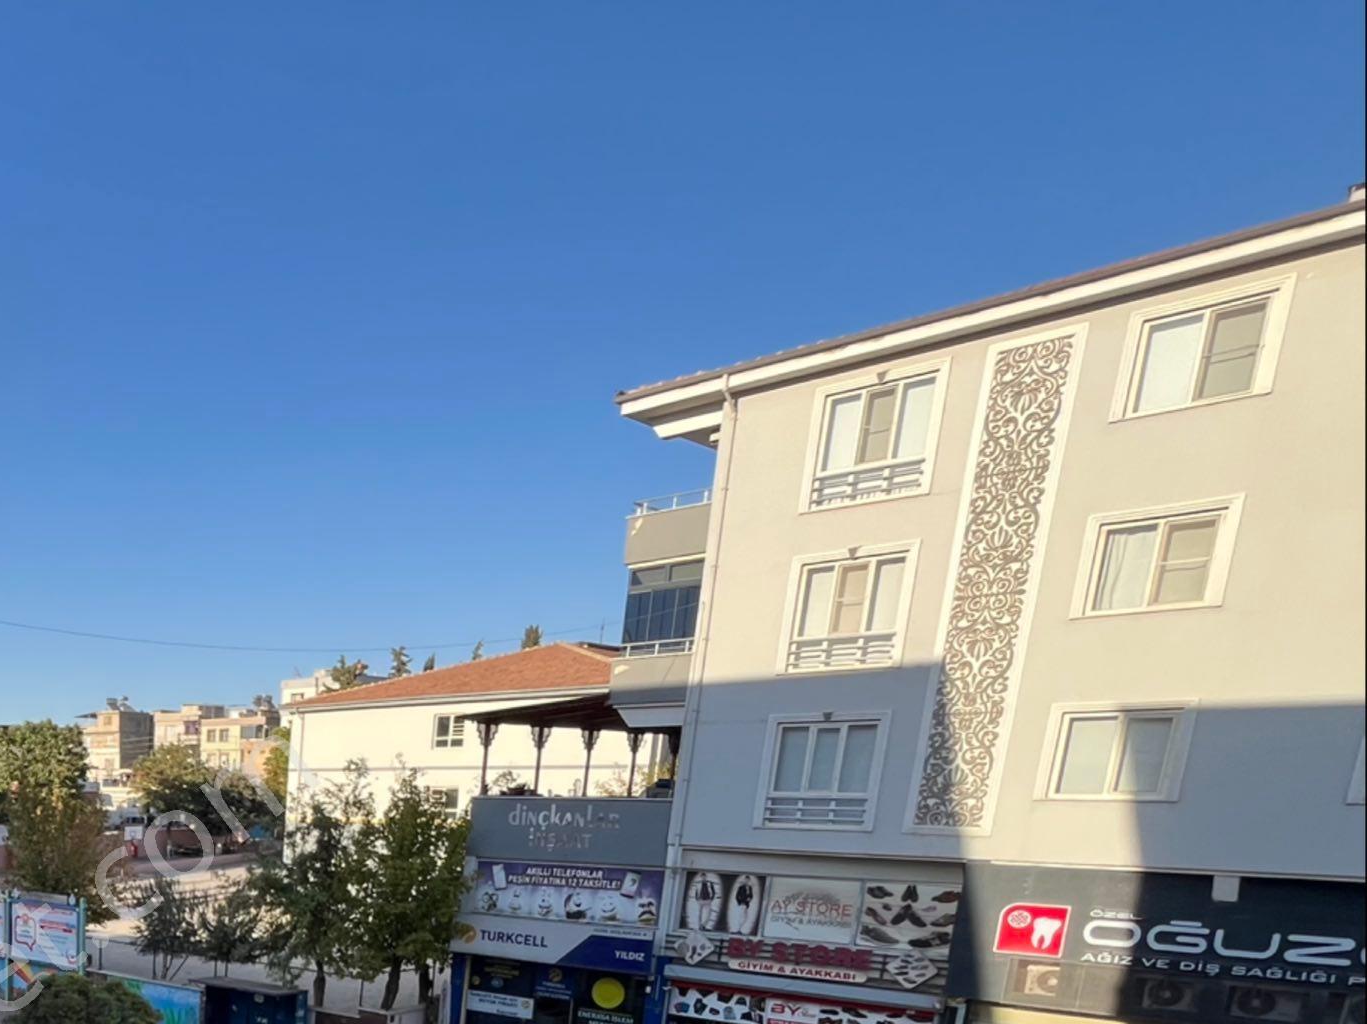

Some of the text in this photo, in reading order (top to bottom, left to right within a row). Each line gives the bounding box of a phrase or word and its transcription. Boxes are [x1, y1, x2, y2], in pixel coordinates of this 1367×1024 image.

[552, 868, 603, 878] TELEFONLAR
[795, 900, 853, 918] STORE
[1089, 908, 1142, 920] ÖZEL
[480, 929, 548, 948] TURKCELL
[614, 950, 645, 961] YILDIZ
[771, 942, 874, 972] STORE
[737, 960, 856, 981] GİYİM & AYAKKABI
[1080, 951, 1133, 966] AĞIZ
[1141, 958, 1170, 969] VE
[1179, 959, 1220, 976] DİŞ
[1231, 964, 1336, 985] SAĞLIĞI
